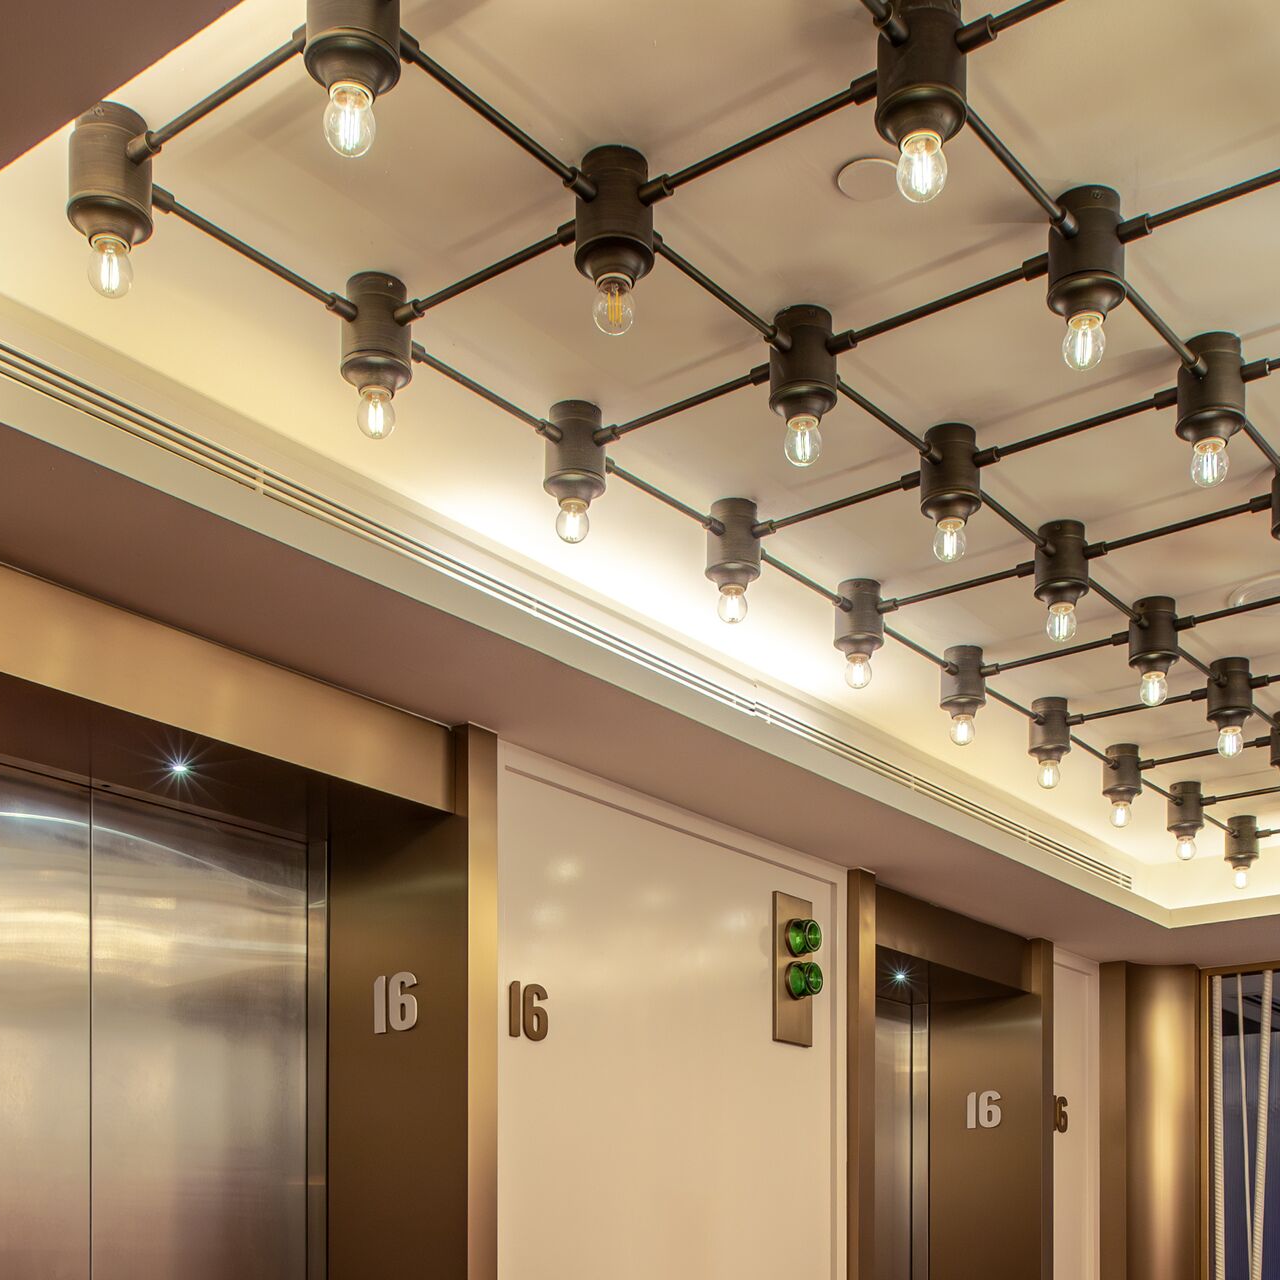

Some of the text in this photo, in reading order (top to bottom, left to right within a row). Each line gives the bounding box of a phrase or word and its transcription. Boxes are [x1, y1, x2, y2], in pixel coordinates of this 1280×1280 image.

[373, 971, 418, 1034] 16
[508, 980, 549, 1042] 16
[966, 1090, 1002, 1129] 16
